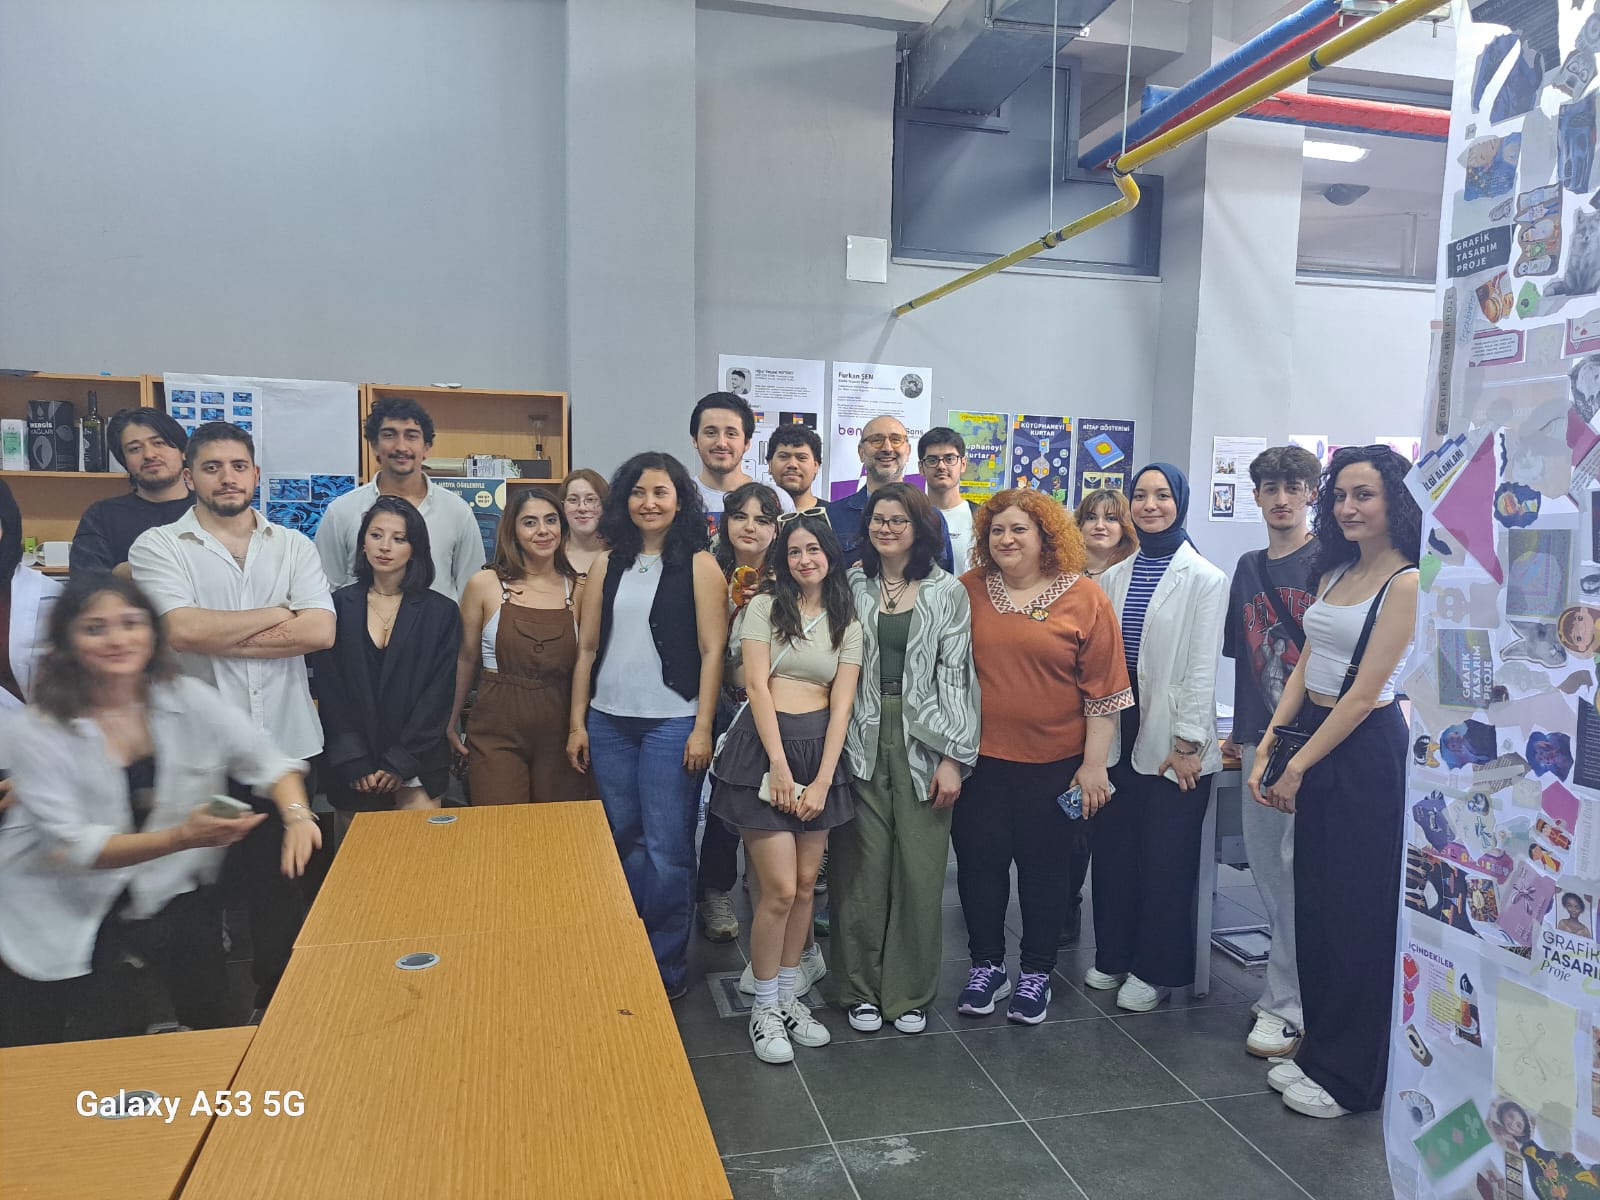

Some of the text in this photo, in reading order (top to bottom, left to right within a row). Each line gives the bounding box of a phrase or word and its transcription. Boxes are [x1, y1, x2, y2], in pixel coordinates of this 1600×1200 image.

[1456, 233, 1490, 251] GRAFİK
[1456, 242, 1497, 262] TASARIM
[1456, 257, 1486, 272] PROJE
[966, 451, 990, 459] urtar
[1435, 449, 1464, 480] ALANLARI
[1472, 645, 1481, 699] TASARIM
[1483, 660, 1492, 700] PROJE
[1408, 942, 1454, 969] İÇİNDEKİLER
[1542, 945, 1600, 981] TASARI
